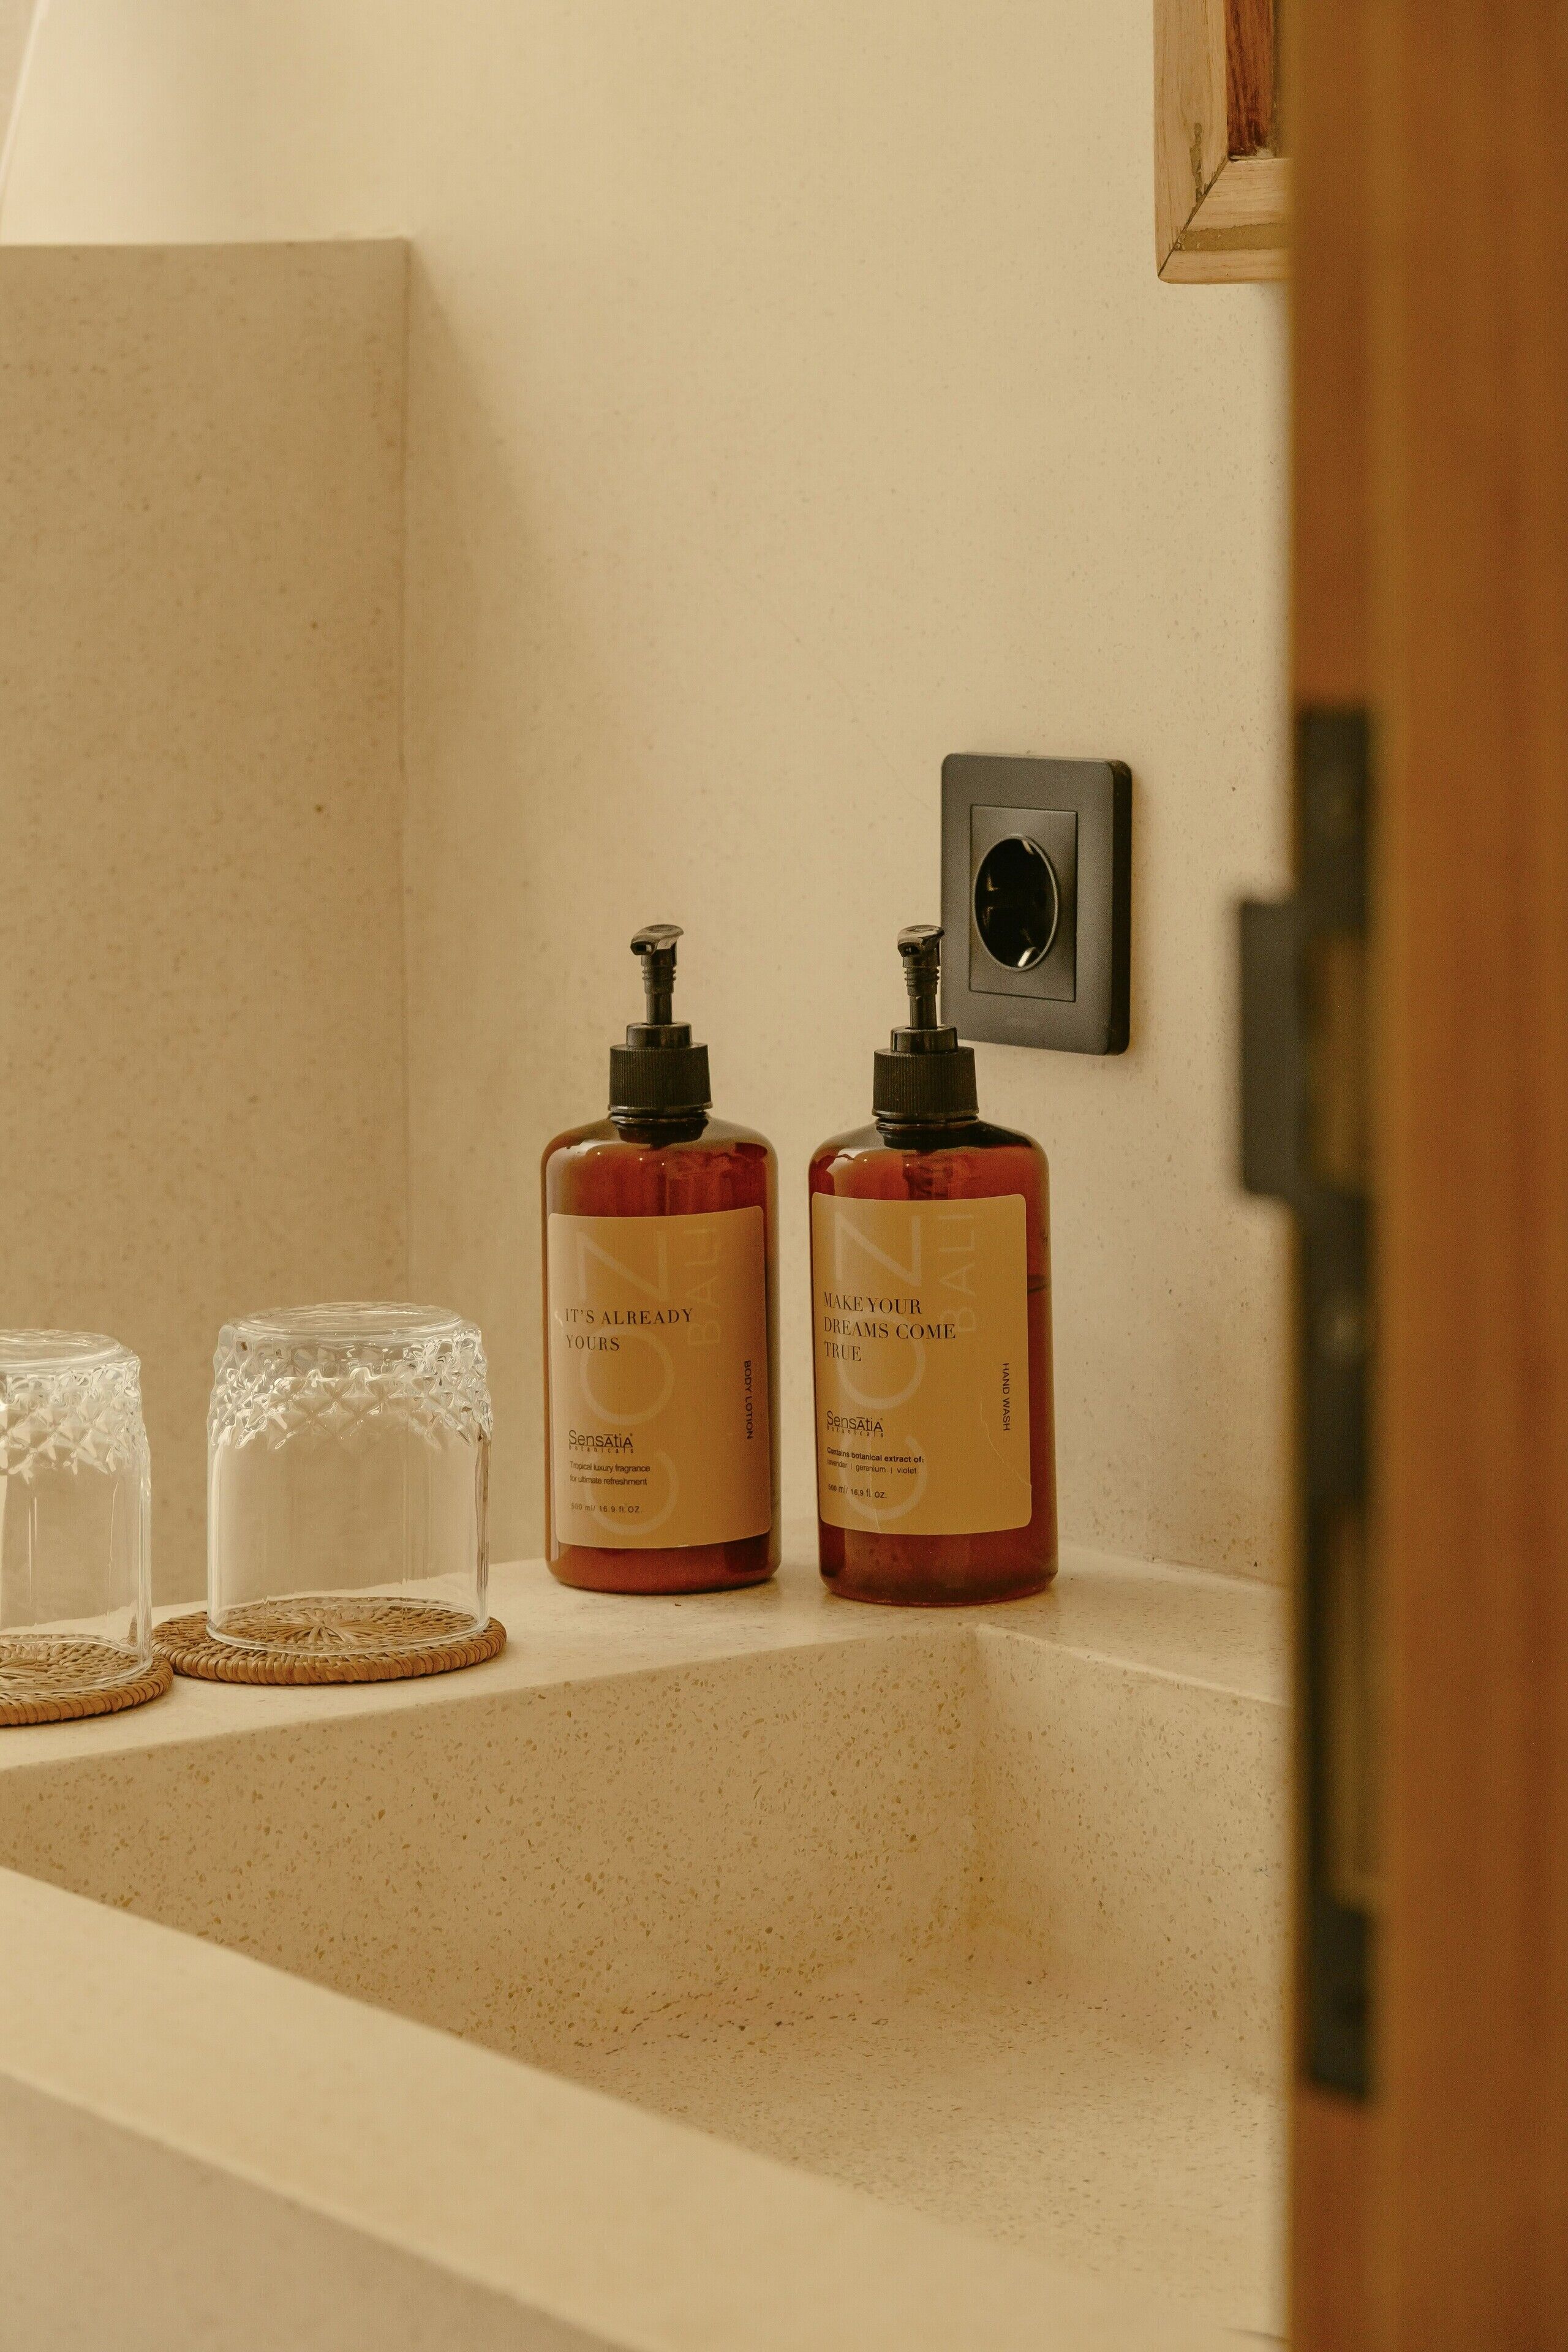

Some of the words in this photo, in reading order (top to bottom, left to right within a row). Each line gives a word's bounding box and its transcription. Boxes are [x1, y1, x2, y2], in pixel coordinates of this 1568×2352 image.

[937, 1213, 977, 1332] BALI
[824, 1291, 863, 1312] MAKE
[866, 1297, 922, 1314] YOUR
[565, 1308, 595, 1324] IT'S
[601, 1308, 693, 1325] ALREADY
[824, 1316, 889, 1339] DREAMS
[896, 1324, 956, 1340] COME
[566, 1334, 620, 1351] YOURS
[824, 1341, 862, 1362] TRUE
[745, 1395, 753, 1439] LOTION
[827, 1447, 850, 1458] Contains
[851, 1451, 882, 1461] botanical
[570, 1461, 592, 1471] Tropical
[593, 1463, 614, 1473] luxury
[615, 1464, 650, 1474] fragrance
[827, 1457, 847, 1468] lavender
[855, 1464, 886, 1472] geranium
[578, 1475, 602, 1483] ultimate
[603, 1477, 647, 1485] refreshment
